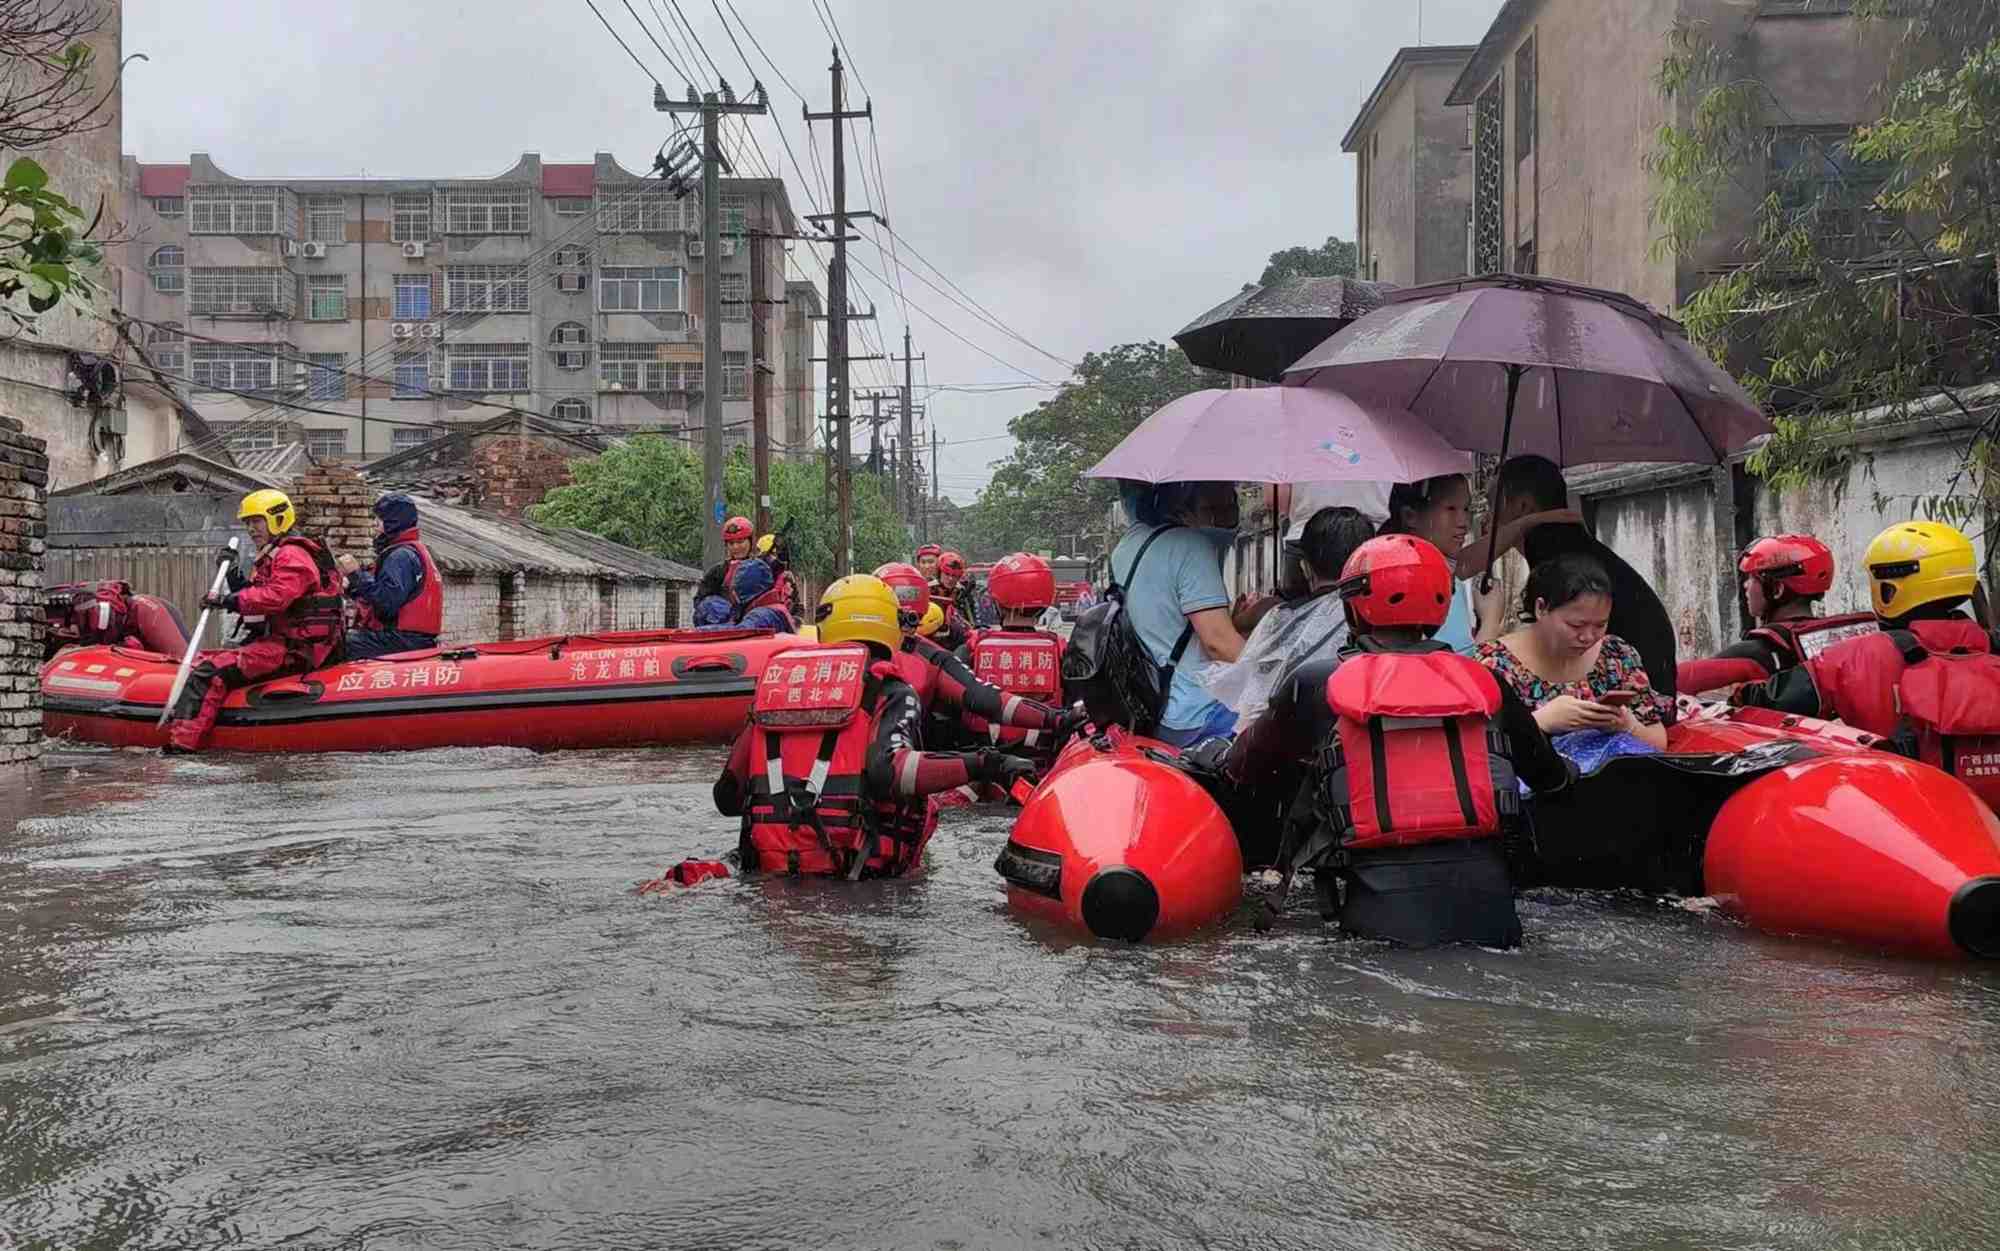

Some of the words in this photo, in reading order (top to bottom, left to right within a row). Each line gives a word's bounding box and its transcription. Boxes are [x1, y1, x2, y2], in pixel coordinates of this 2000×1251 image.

[624, 647, 657, 660] BOAT
[980, 651, 1053, 671] 应急消防
[336, 665, 463, 691] 应急消防
[570, 658, 661, 681] 沧龙船舶
[762, 659, 860, 685] 应急消防
[767, 687, 844, 704] 广西北海
